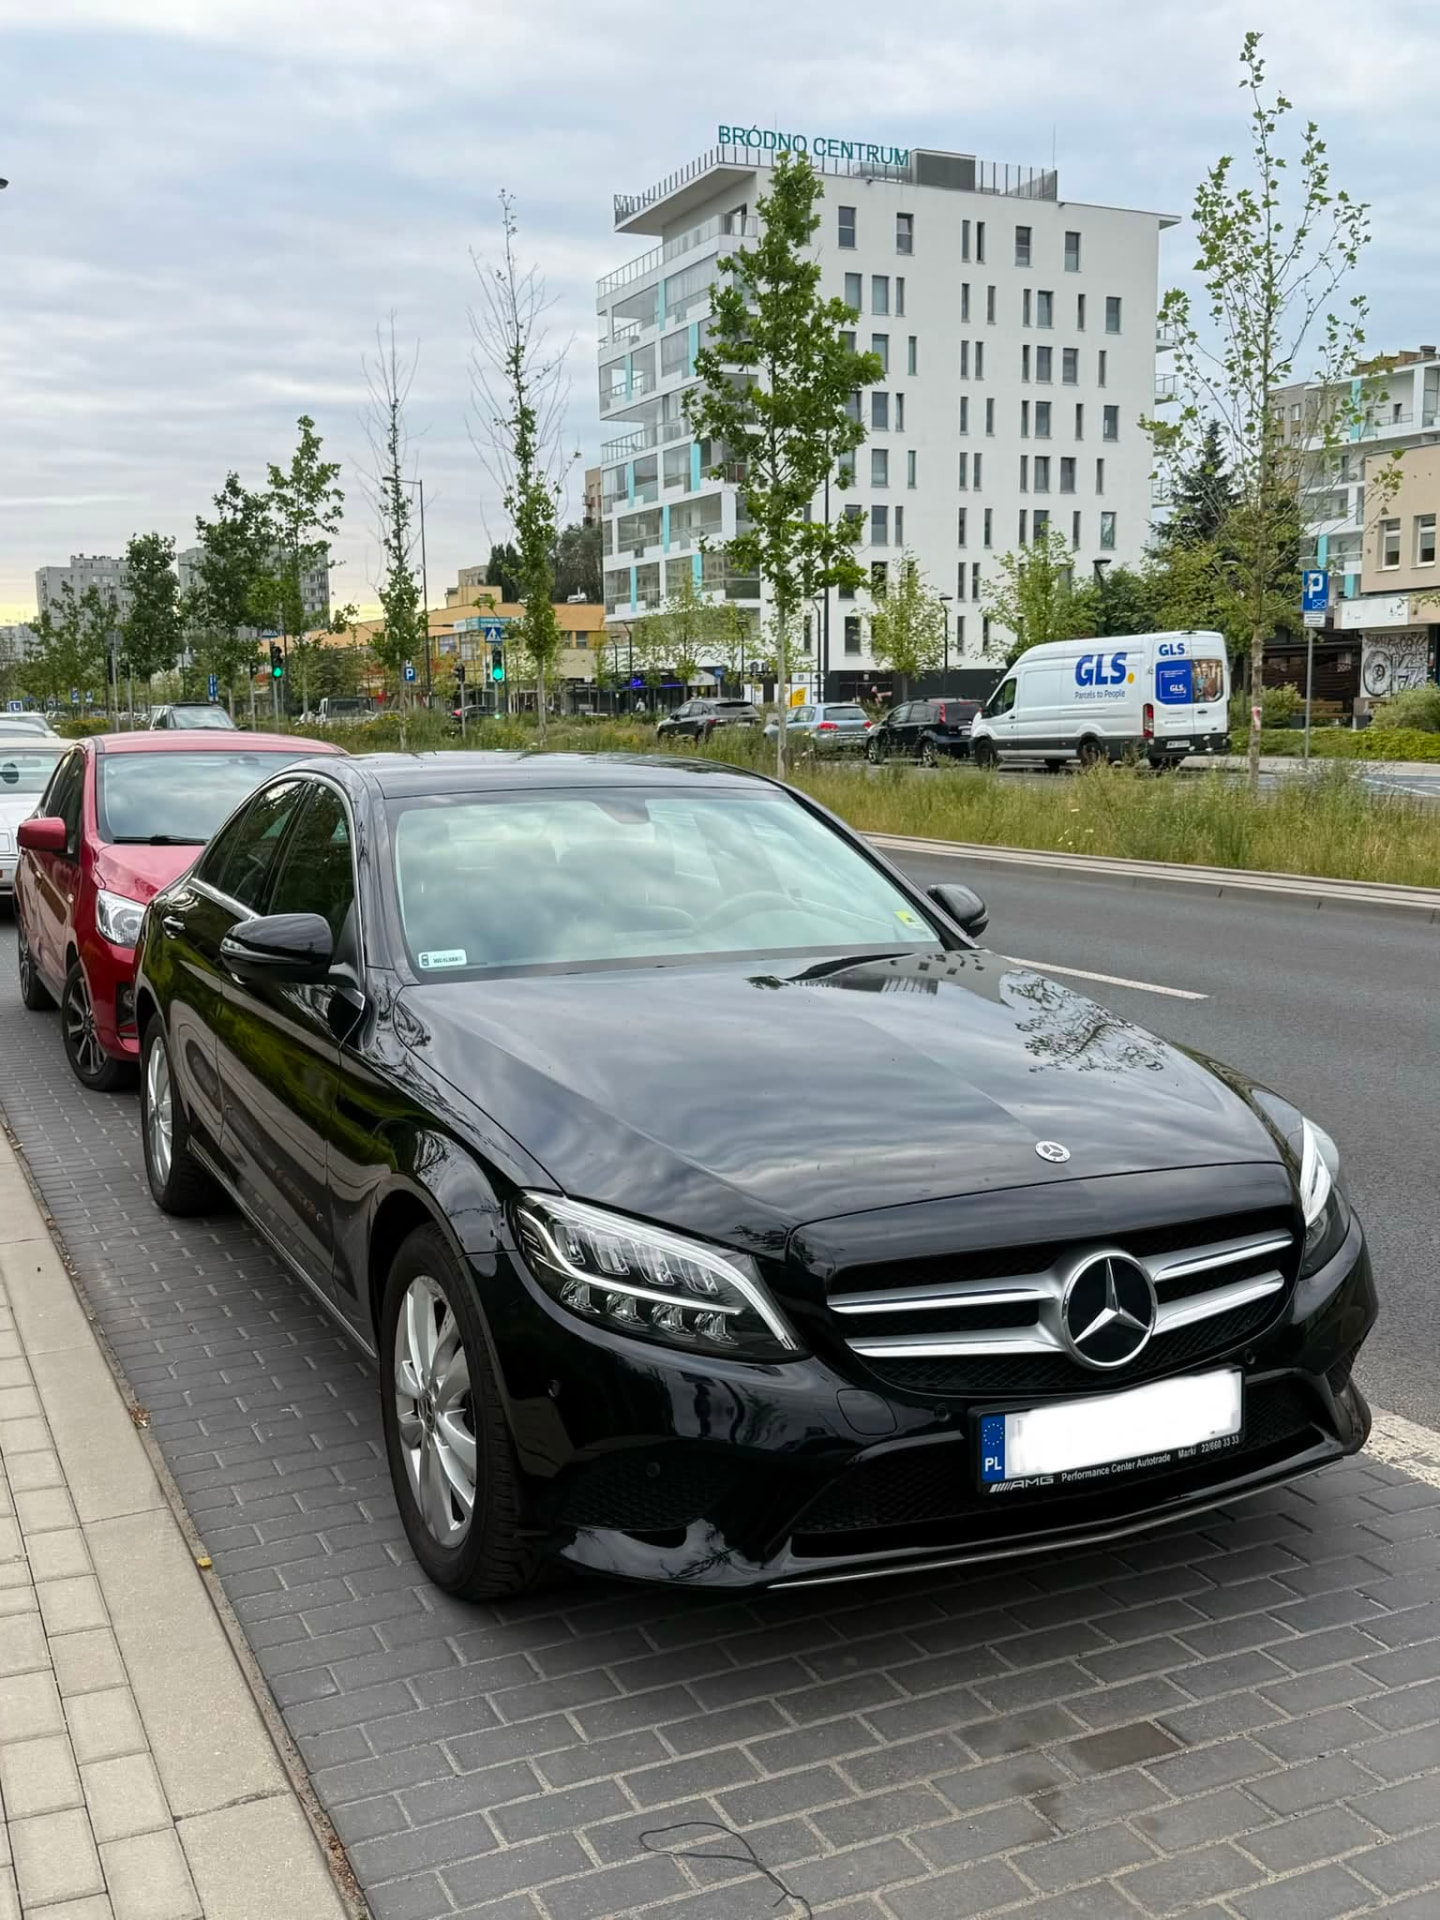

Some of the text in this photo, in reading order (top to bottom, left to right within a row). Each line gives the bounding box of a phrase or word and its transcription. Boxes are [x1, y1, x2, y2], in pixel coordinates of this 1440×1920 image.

[719, 125, 909, 166] BRÓDNO CENTRUM
[1308, 572, 1323, 599] P
[406, 669, 414, 679] P
[1096, 690, 1104, 698] to
[1104, 688, 1126, 699] People
[984, 1456, 1003, 1472] PL
[1062, 1467, 1110, 1482] Performance
[1111, 1458, 1136, 1473] Center
[1137, 1453, 1171, 1467] Autotrade
